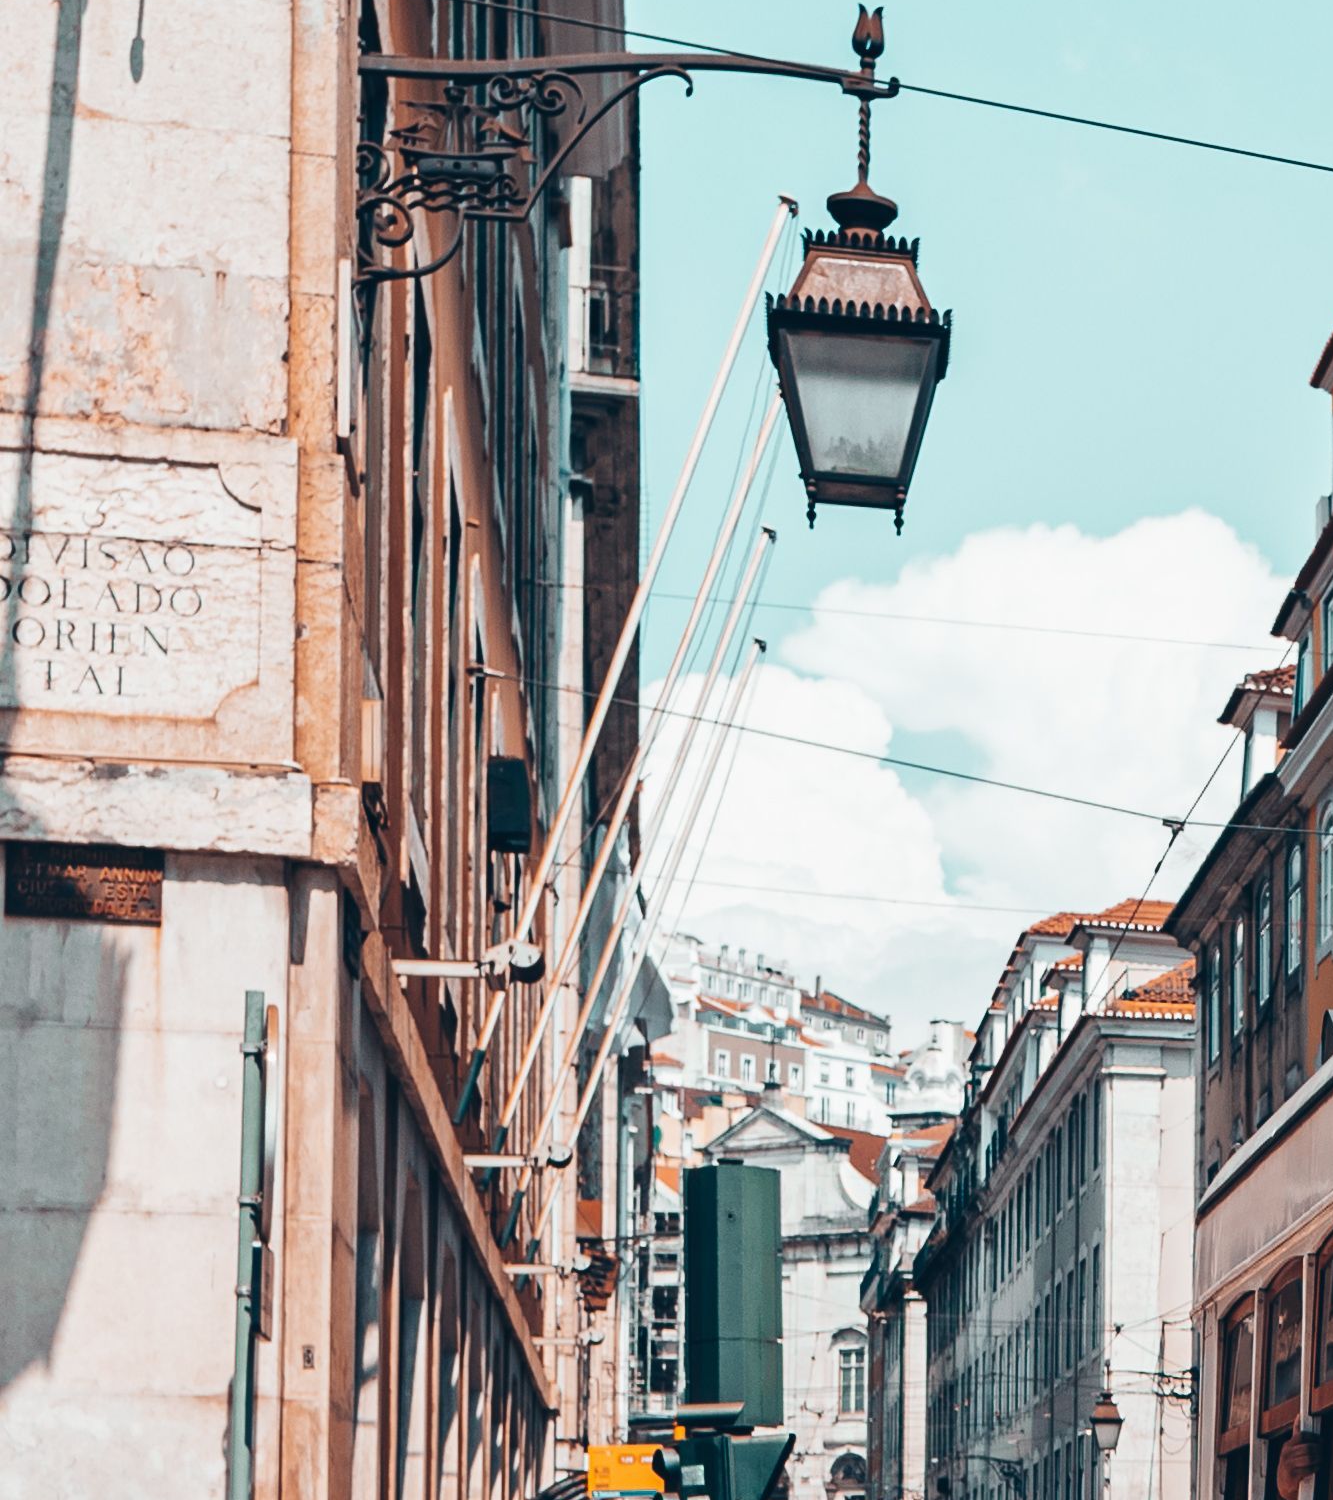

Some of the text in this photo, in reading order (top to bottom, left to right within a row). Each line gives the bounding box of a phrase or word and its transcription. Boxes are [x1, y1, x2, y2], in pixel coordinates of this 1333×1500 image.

[12, 616, 170, 656] ORIEN
[34, 658, 141, 698] TAL
[104, 882, 150, 899] ESTA
